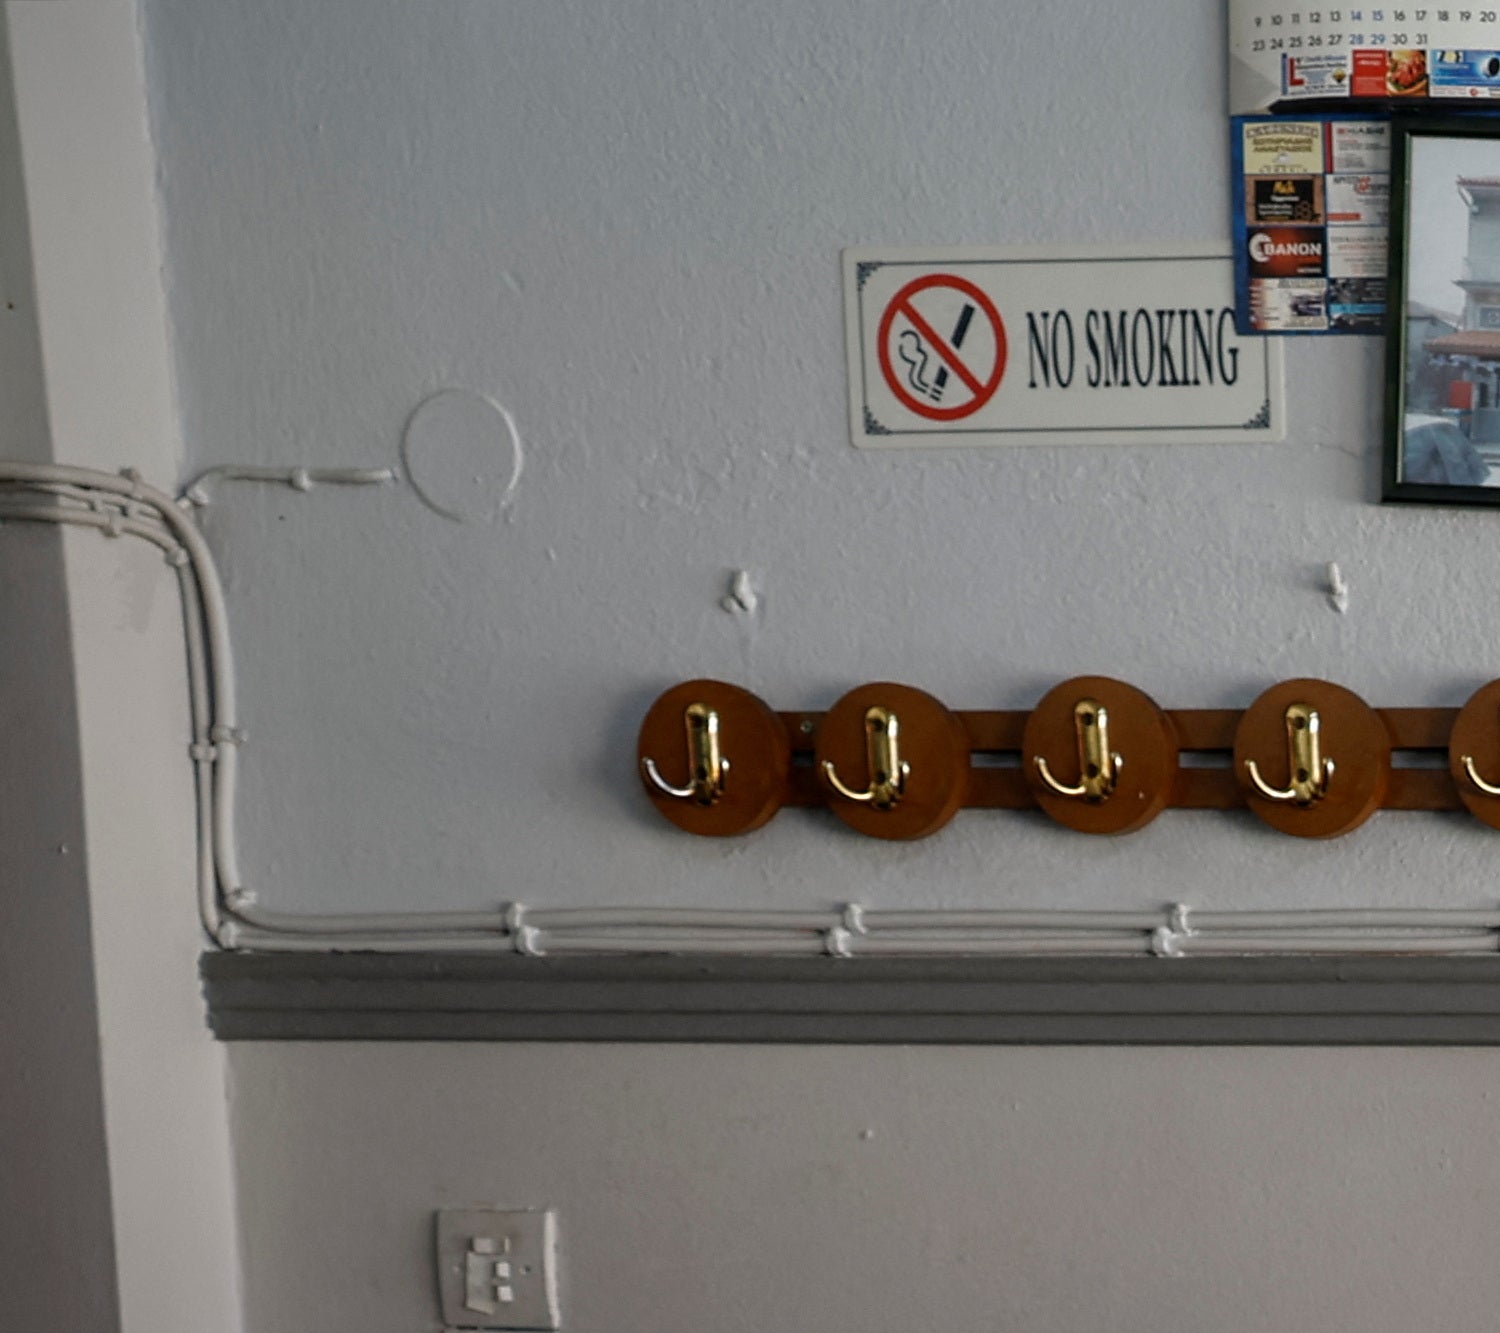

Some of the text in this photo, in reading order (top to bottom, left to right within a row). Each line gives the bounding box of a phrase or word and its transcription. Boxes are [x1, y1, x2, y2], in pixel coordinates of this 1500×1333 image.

[1255, 17, 1262, 27] 9
[1271, 14, 1282, 26] 10
[1291, 13, 1300, 24] 11
[1309, 12, 1321, 24] 12
[1330, 11, 1341, 22] 13
[1351, 11, 1362, 21] 14
[1372, 10, 1383, 21] 15
[1393, 10, 1405, 21] 16
[1416, 10, 1427, 21] 17
[1438, 11, 1449, 22] 18
[1460, 10, 1471, 22] 19
[1480, 10, 1496, 22] 20
[1252, 33, 1427, 51] 23 24 25 26 27 28 29 30 31
[1026, 307, 1240, 389] NO SMOKING
